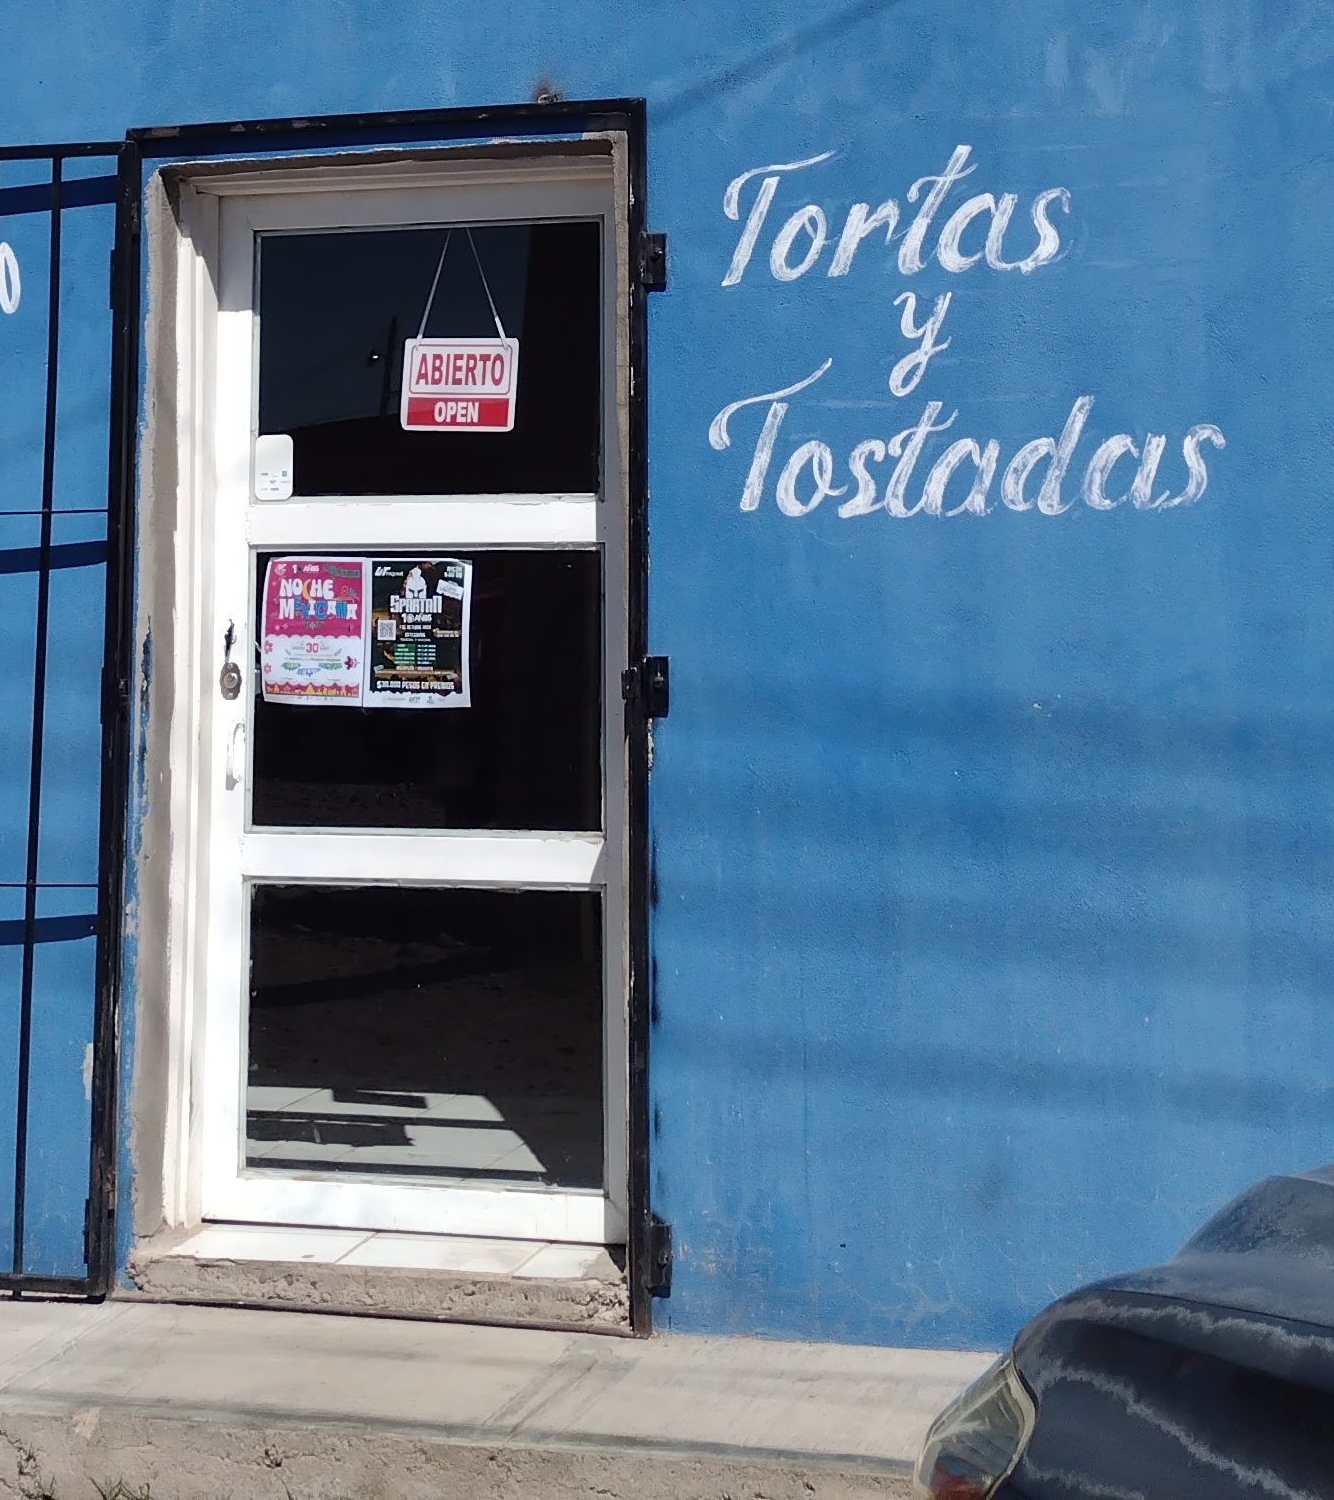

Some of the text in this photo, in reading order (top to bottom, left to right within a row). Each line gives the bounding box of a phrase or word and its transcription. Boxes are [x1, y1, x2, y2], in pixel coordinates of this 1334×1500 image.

[722, 144, 1071, 288] Tortas
[889, 291, 952, 397] y
[414, 353, 505, 386] ABIERTO
[433, 401, 480, 424] OPEN
[708, 357, 1227, 519] Tostadas
[279, 578, 335, 600] NOCHE
[305, 642, 320, 654] 30
